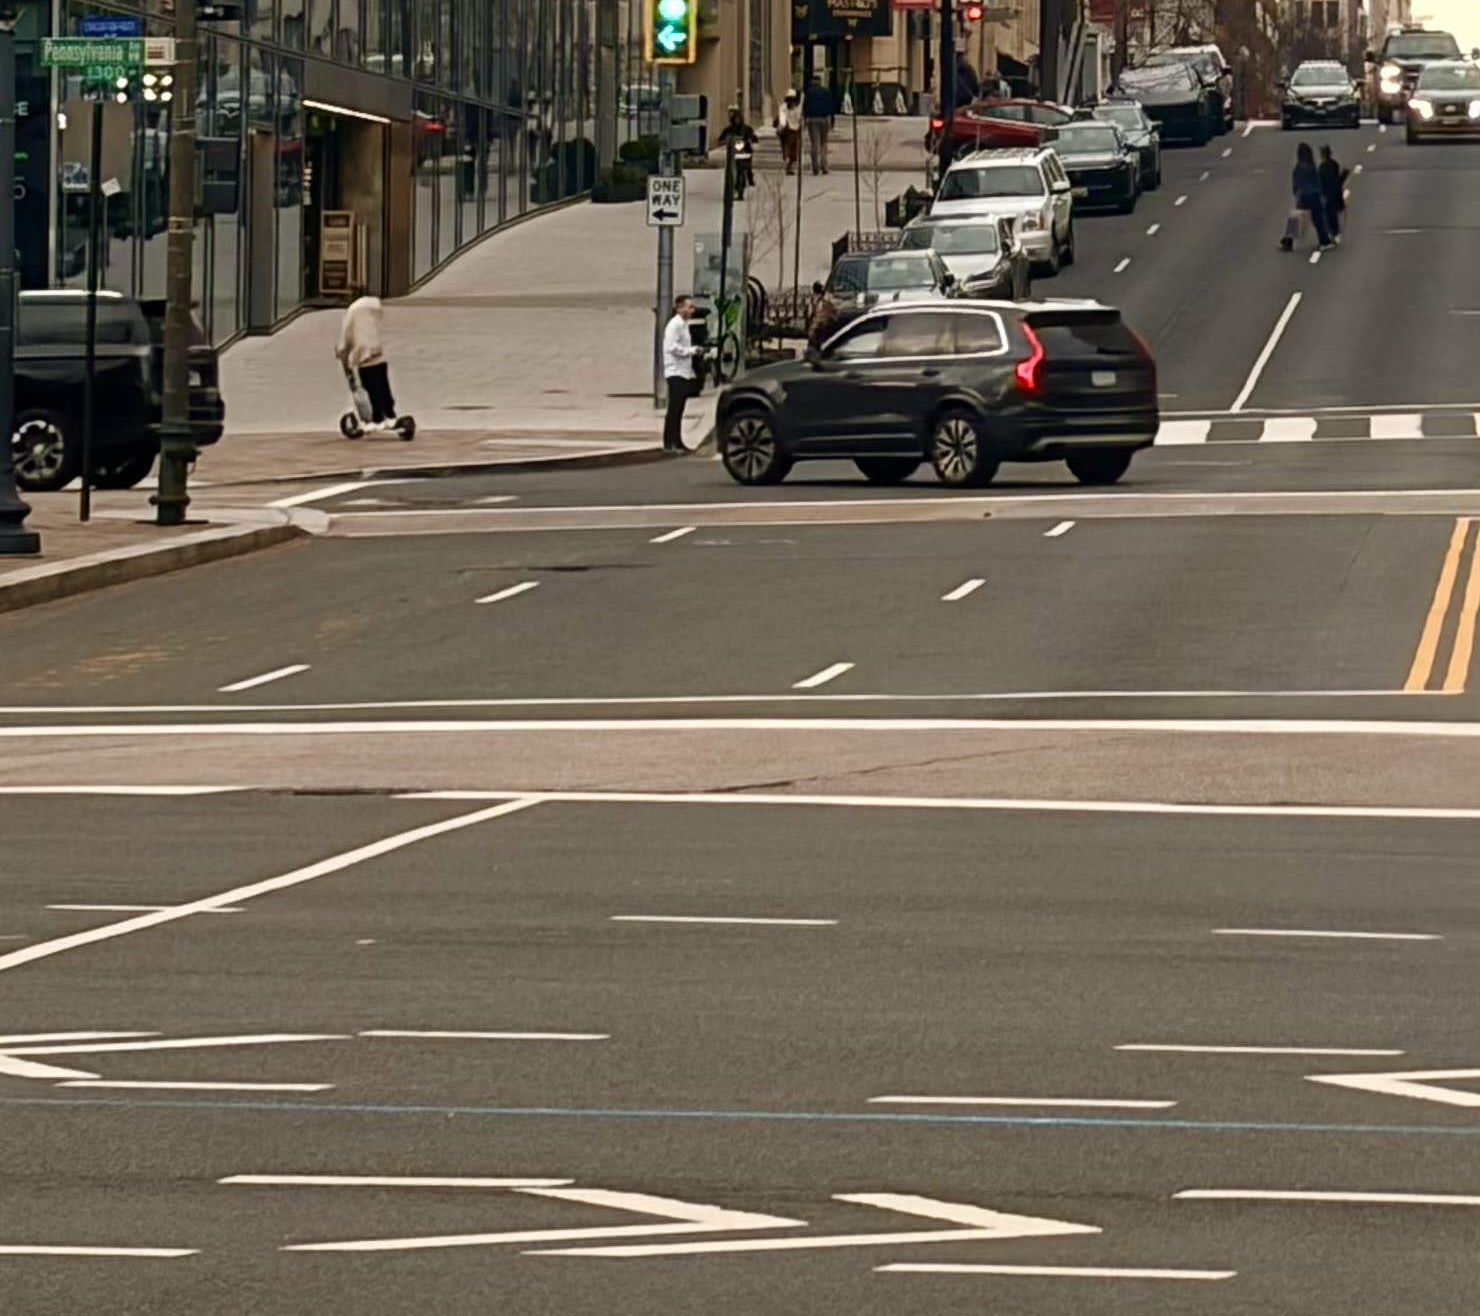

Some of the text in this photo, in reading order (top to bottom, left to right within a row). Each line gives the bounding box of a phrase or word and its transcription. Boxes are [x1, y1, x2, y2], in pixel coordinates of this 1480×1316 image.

[43, 39, 124, 66] Pennsylvania
[652, 180, 681, 193] ONE
[652, 193, 681, 207] WAY
